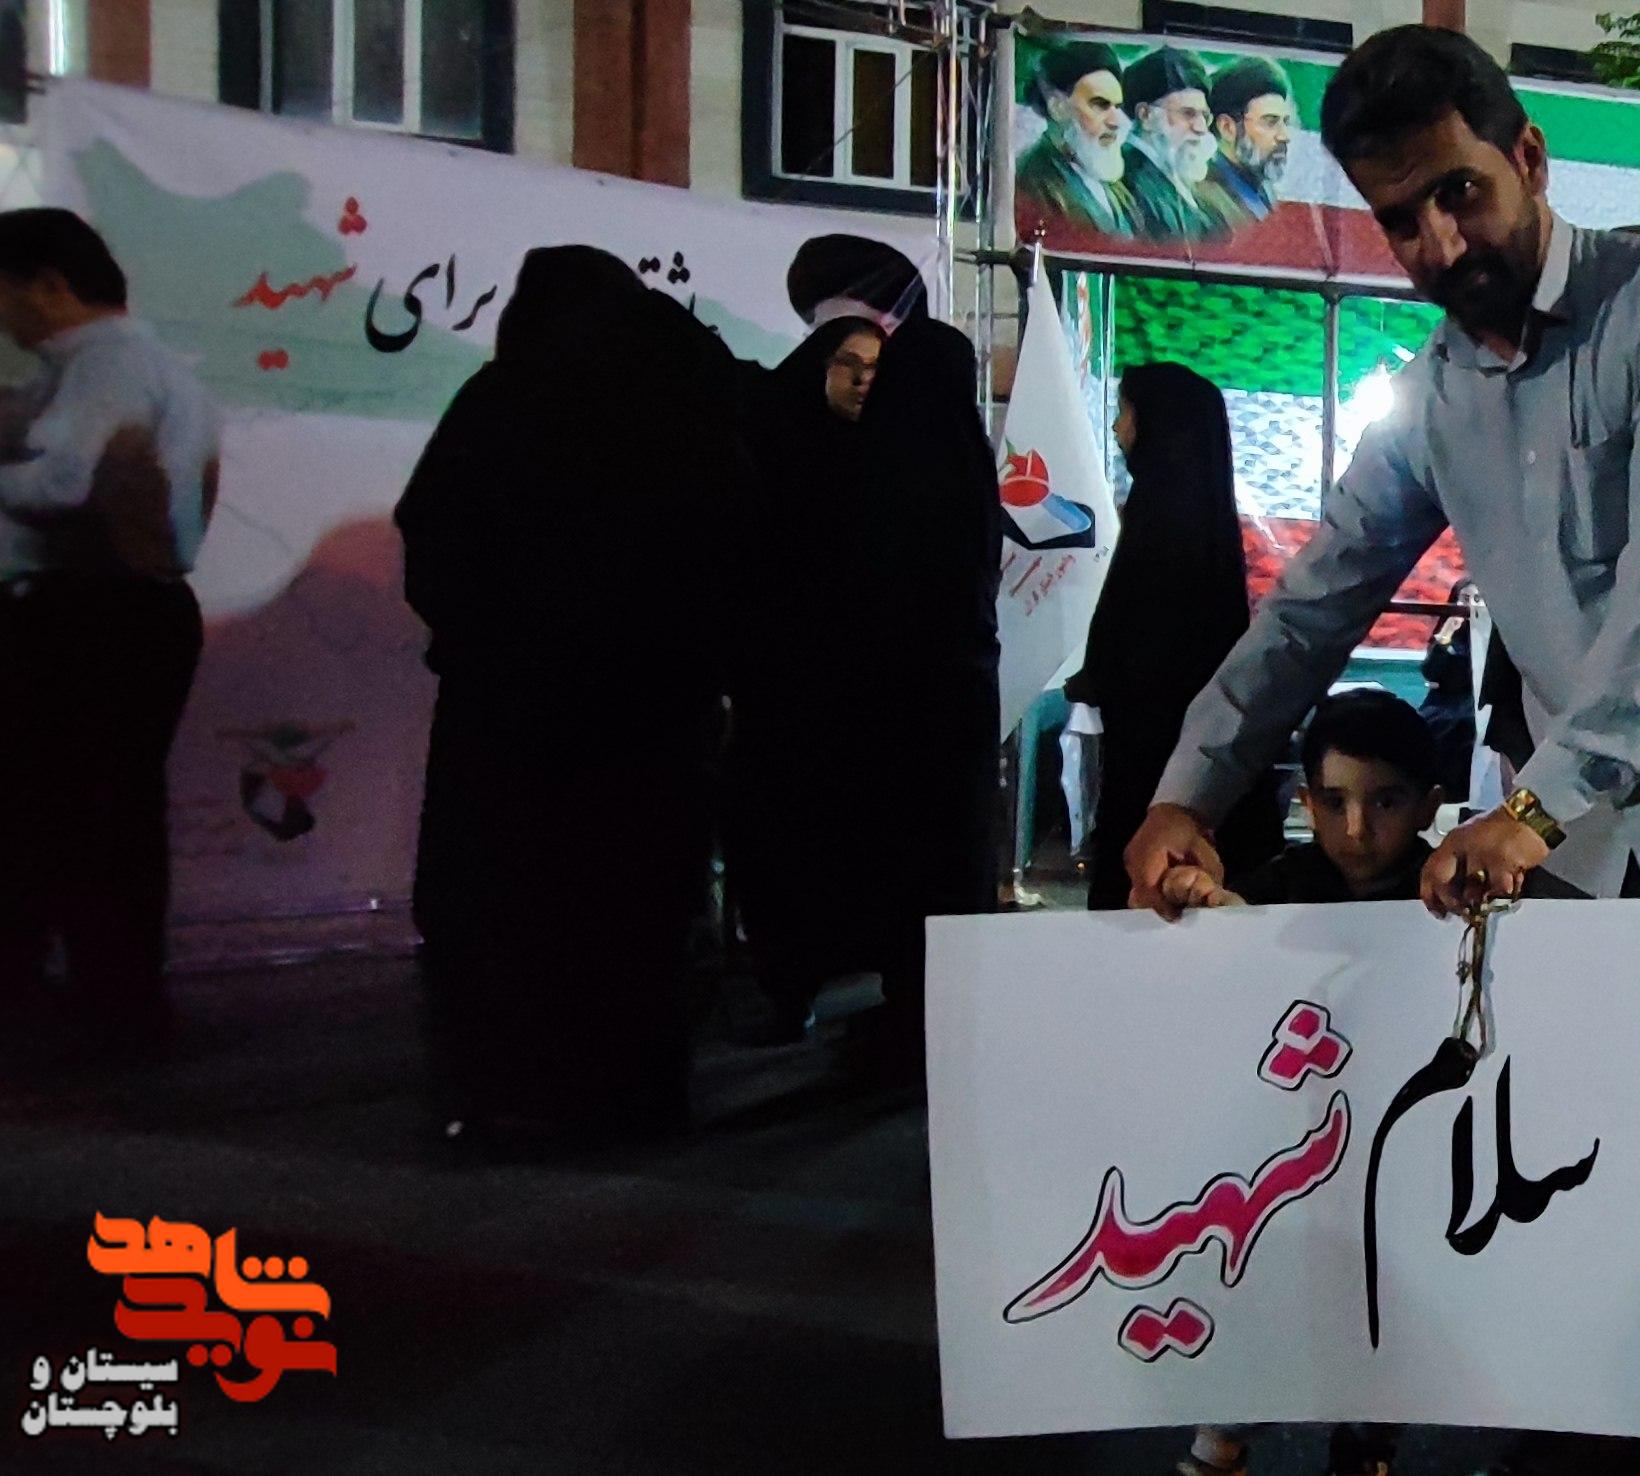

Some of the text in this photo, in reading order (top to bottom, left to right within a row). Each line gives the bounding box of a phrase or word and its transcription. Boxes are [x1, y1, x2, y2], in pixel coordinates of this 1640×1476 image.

[230, 196, 368, 371] شهید
[364, 252, 498, 353] برای
[1003, 999, 1601, 1363] سلام شهید
